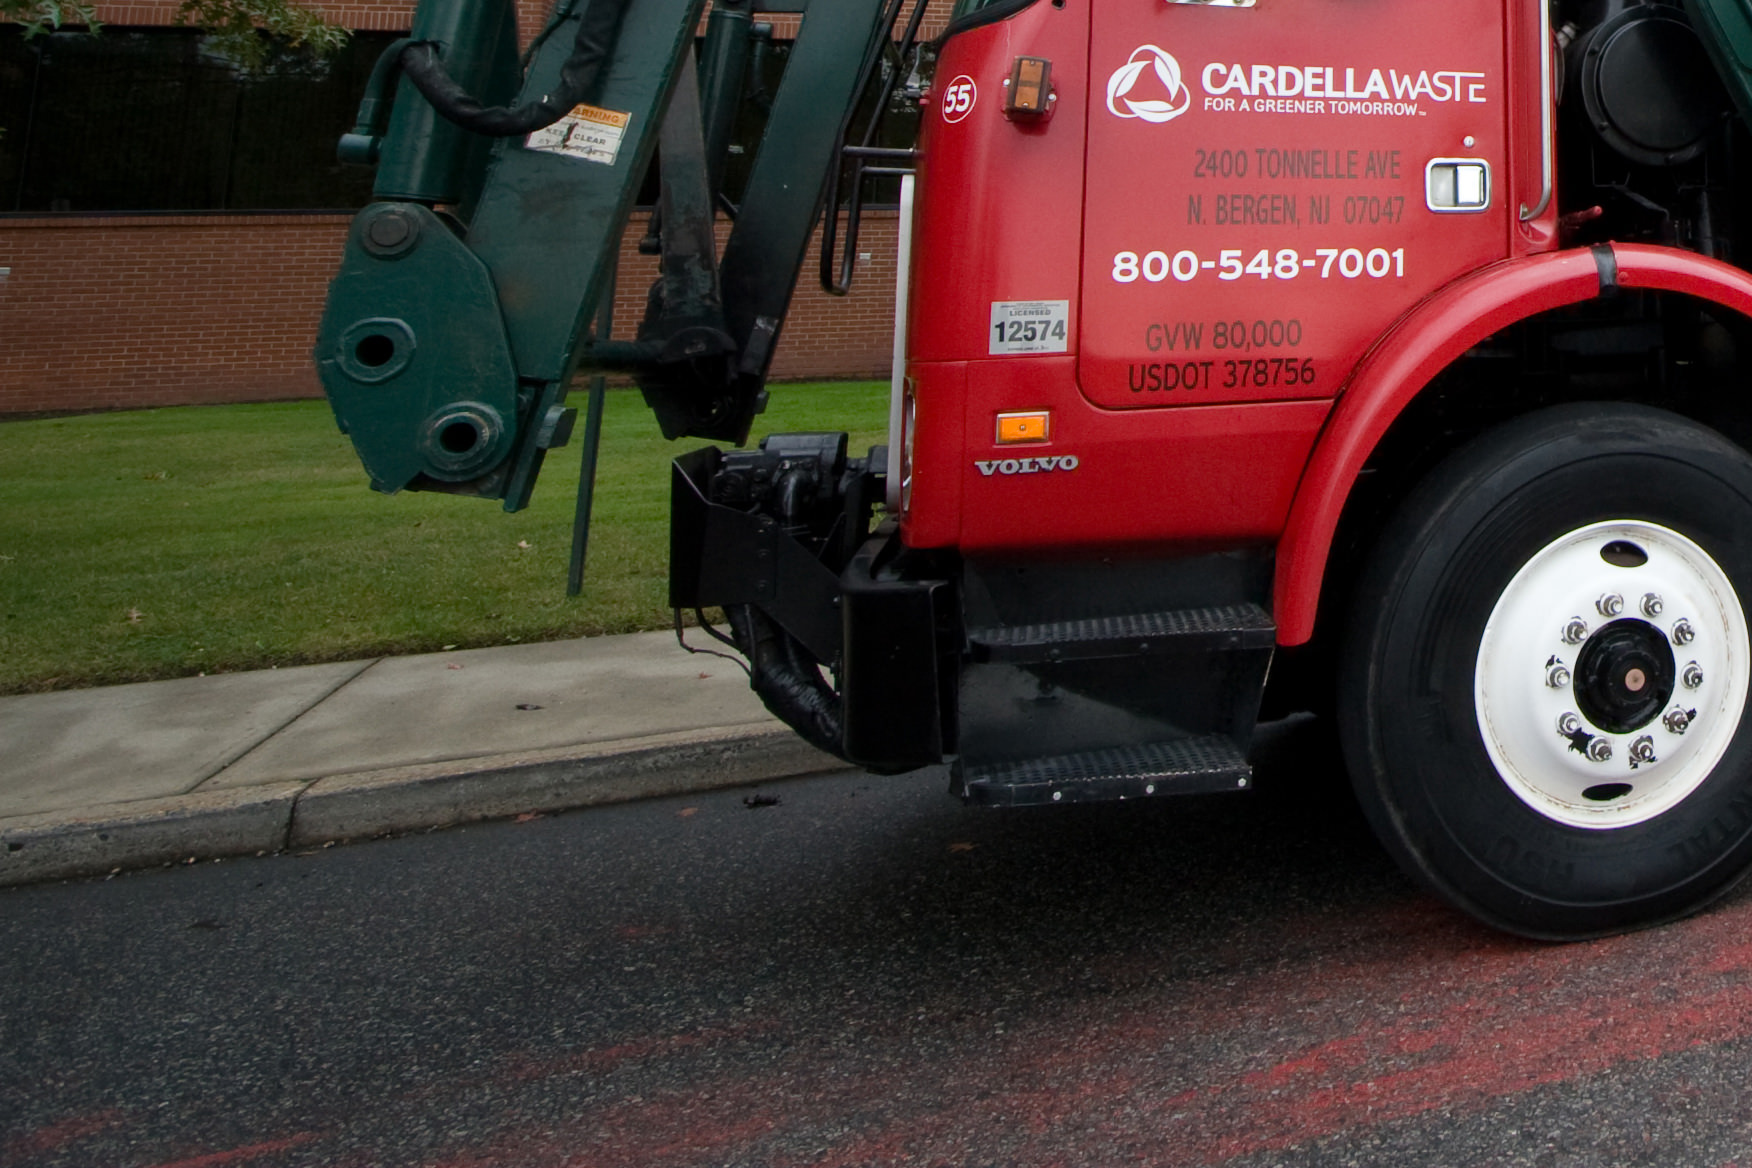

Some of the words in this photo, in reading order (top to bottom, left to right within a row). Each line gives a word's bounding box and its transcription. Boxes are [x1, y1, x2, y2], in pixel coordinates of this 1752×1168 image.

[944, 84, 972, 114] 55
[1204, 97, 1236, 112] FOR
[1238, 98, 1251, 112] A
[1253, 99, 1325, 114] GREENER
[1328, 100, 1419, 116] TOMORROW
[573, 133, 607, 145] CLEAR
[1194, 149, 1248, 179] 2400
[1255, 148, 1359, 179] TONNELLE
[1365, 150, 1401, 179] AVE
[1187, 194, 1206, 225] N.
[1215, 194, 1301, 227] BERGEN,
[1309, 195, 1331, 224] NJ
[1343, 196, 1405, 224] 07047
[1111, 248, 1404, 283] 800-548-7001
[1009, 309, 1052, 317] LICENSED
[994, 319, 1066, 343] 12574
[1145, 321, 1204, 352] GVW
[1212, 319, 1302, 352] 80,000
[1129, 360, 1215, 393] USDOT
[1223, 357, 1316, 388] 378756
[974, 455, 1080, 477] VOLVO
